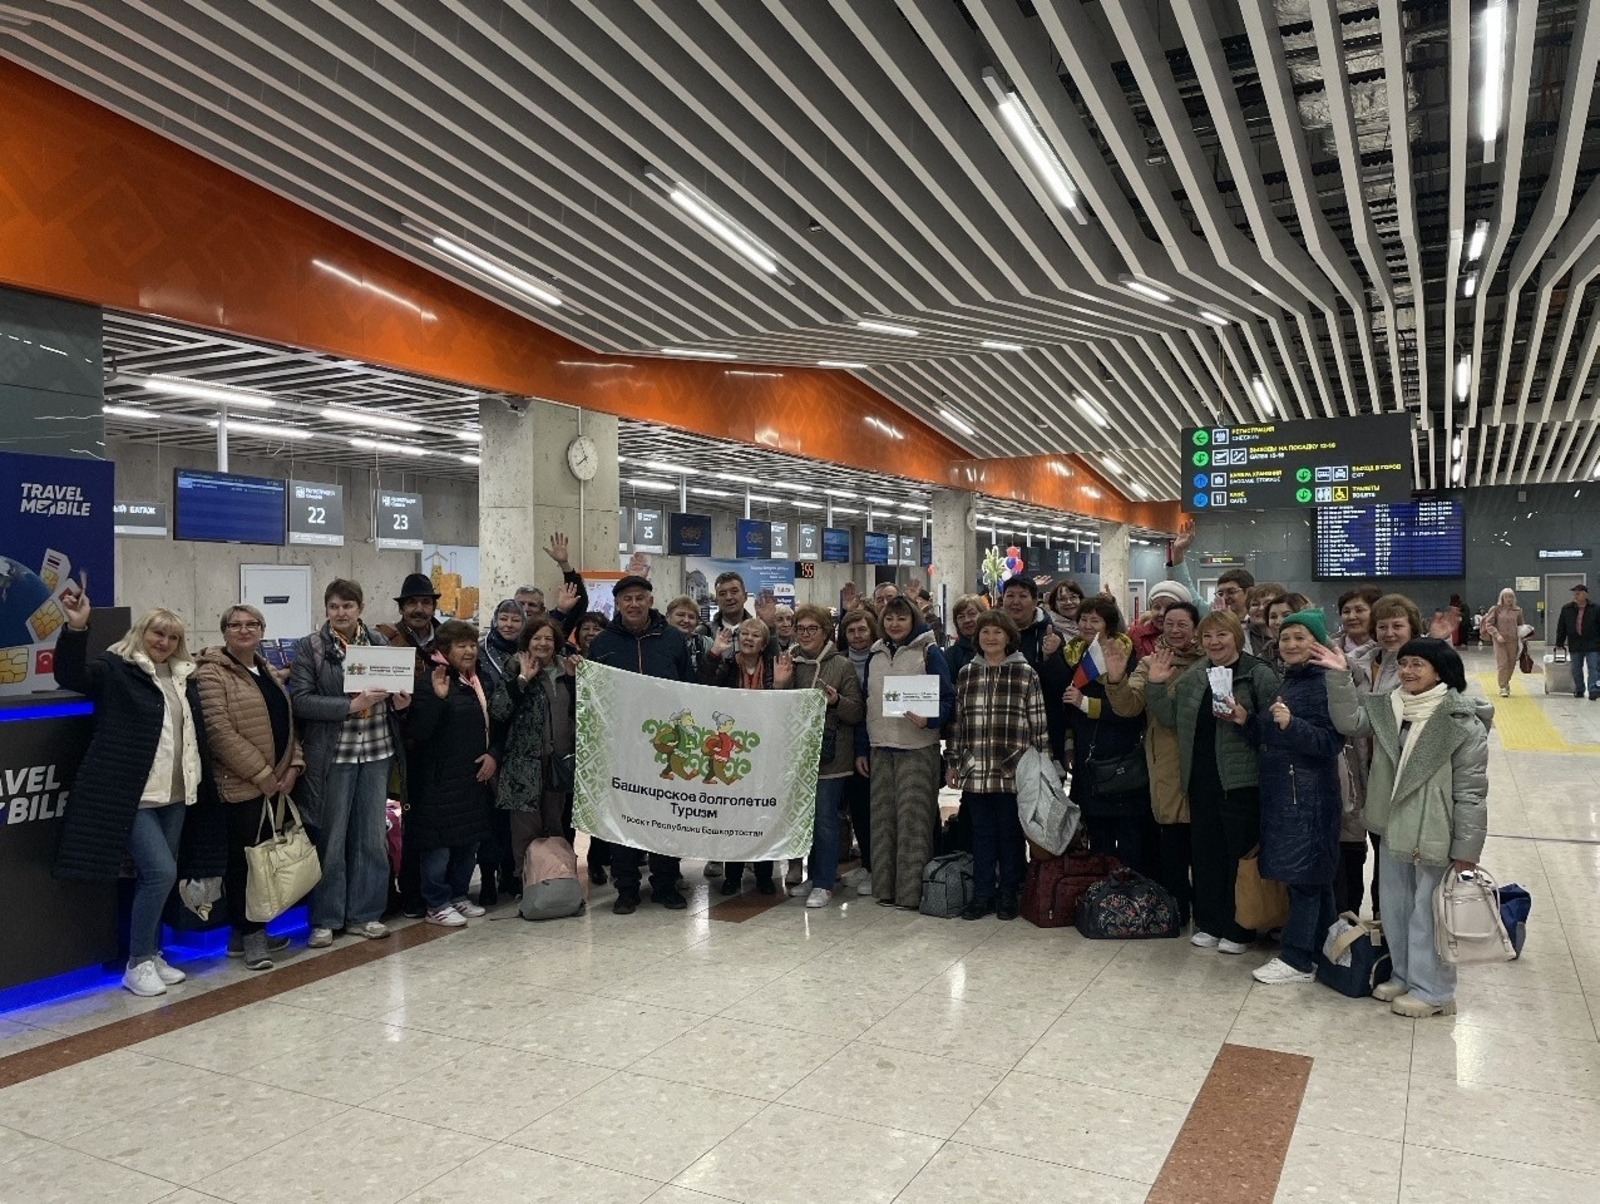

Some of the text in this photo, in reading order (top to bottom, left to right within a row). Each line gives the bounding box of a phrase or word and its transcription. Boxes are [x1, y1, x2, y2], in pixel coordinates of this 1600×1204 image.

[20, 482, 84, 501] TRAVEL
[129, 505, 156, 514] БАГАЖ
[307, 506, 326, 524] 22
[393, 513, 409, 530] 23
[0, 764, 60, 797] VEL
[611, 776, 777, 807] Башкирское долголетие
[670, 802, 718, 820] Туризм
[621, 813, 763, 838] проект Республики Башкортостан
